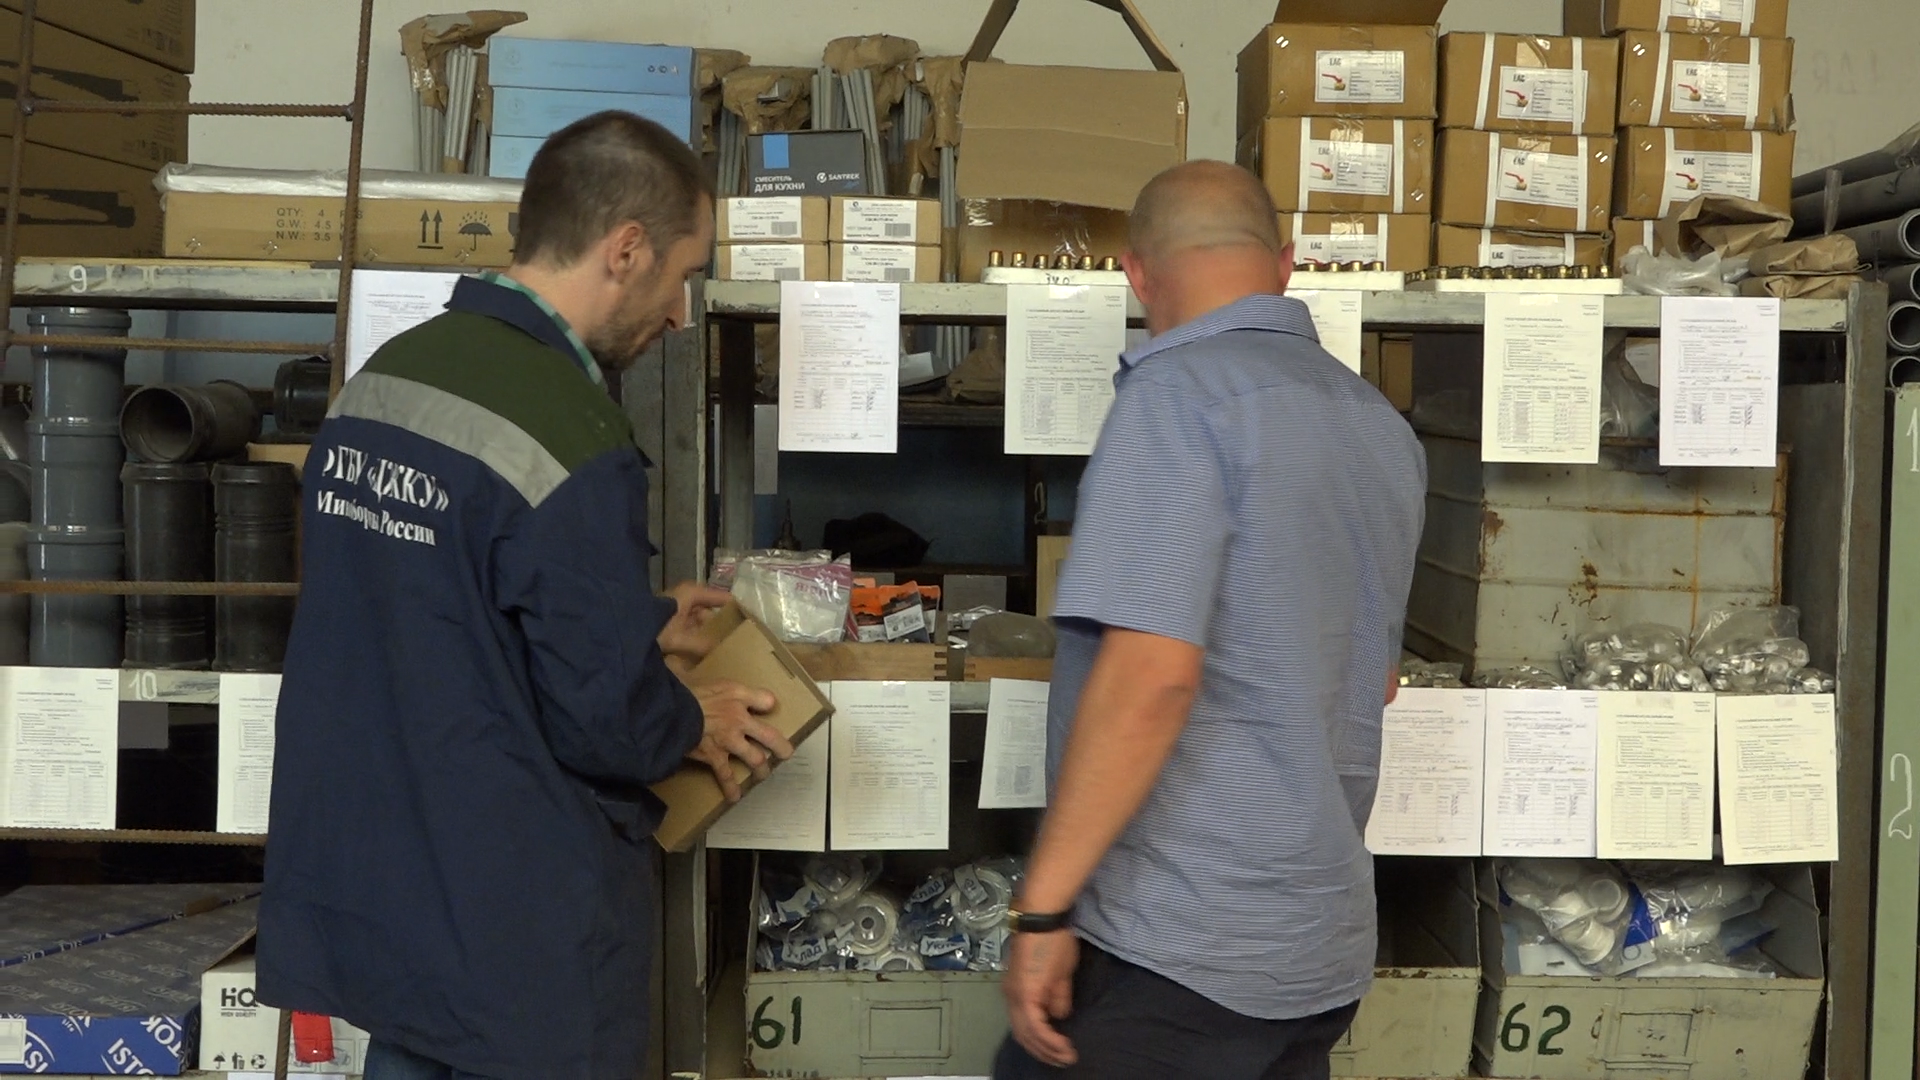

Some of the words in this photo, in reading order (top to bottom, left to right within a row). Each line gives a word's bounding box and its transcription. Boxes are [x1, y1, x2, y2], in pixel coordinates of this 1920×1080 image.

[754, 183, 773, 194] ДЛЯ
[775, 182, 806, 192] КУХНИ
[276, 207, 304, 217] QTY:
[318, 209, 324, 217] 4
[68, 265, 87, 293] 9
[1906, 407, 1920, 472] 1
[379, 509, 436, 547] России
[128, 671, 158, 700] 10
[1888, 752, 1913, 840] 2
[752, 996, 803, 1049] 61
[1500, 1002, 1571, 1055] 62
